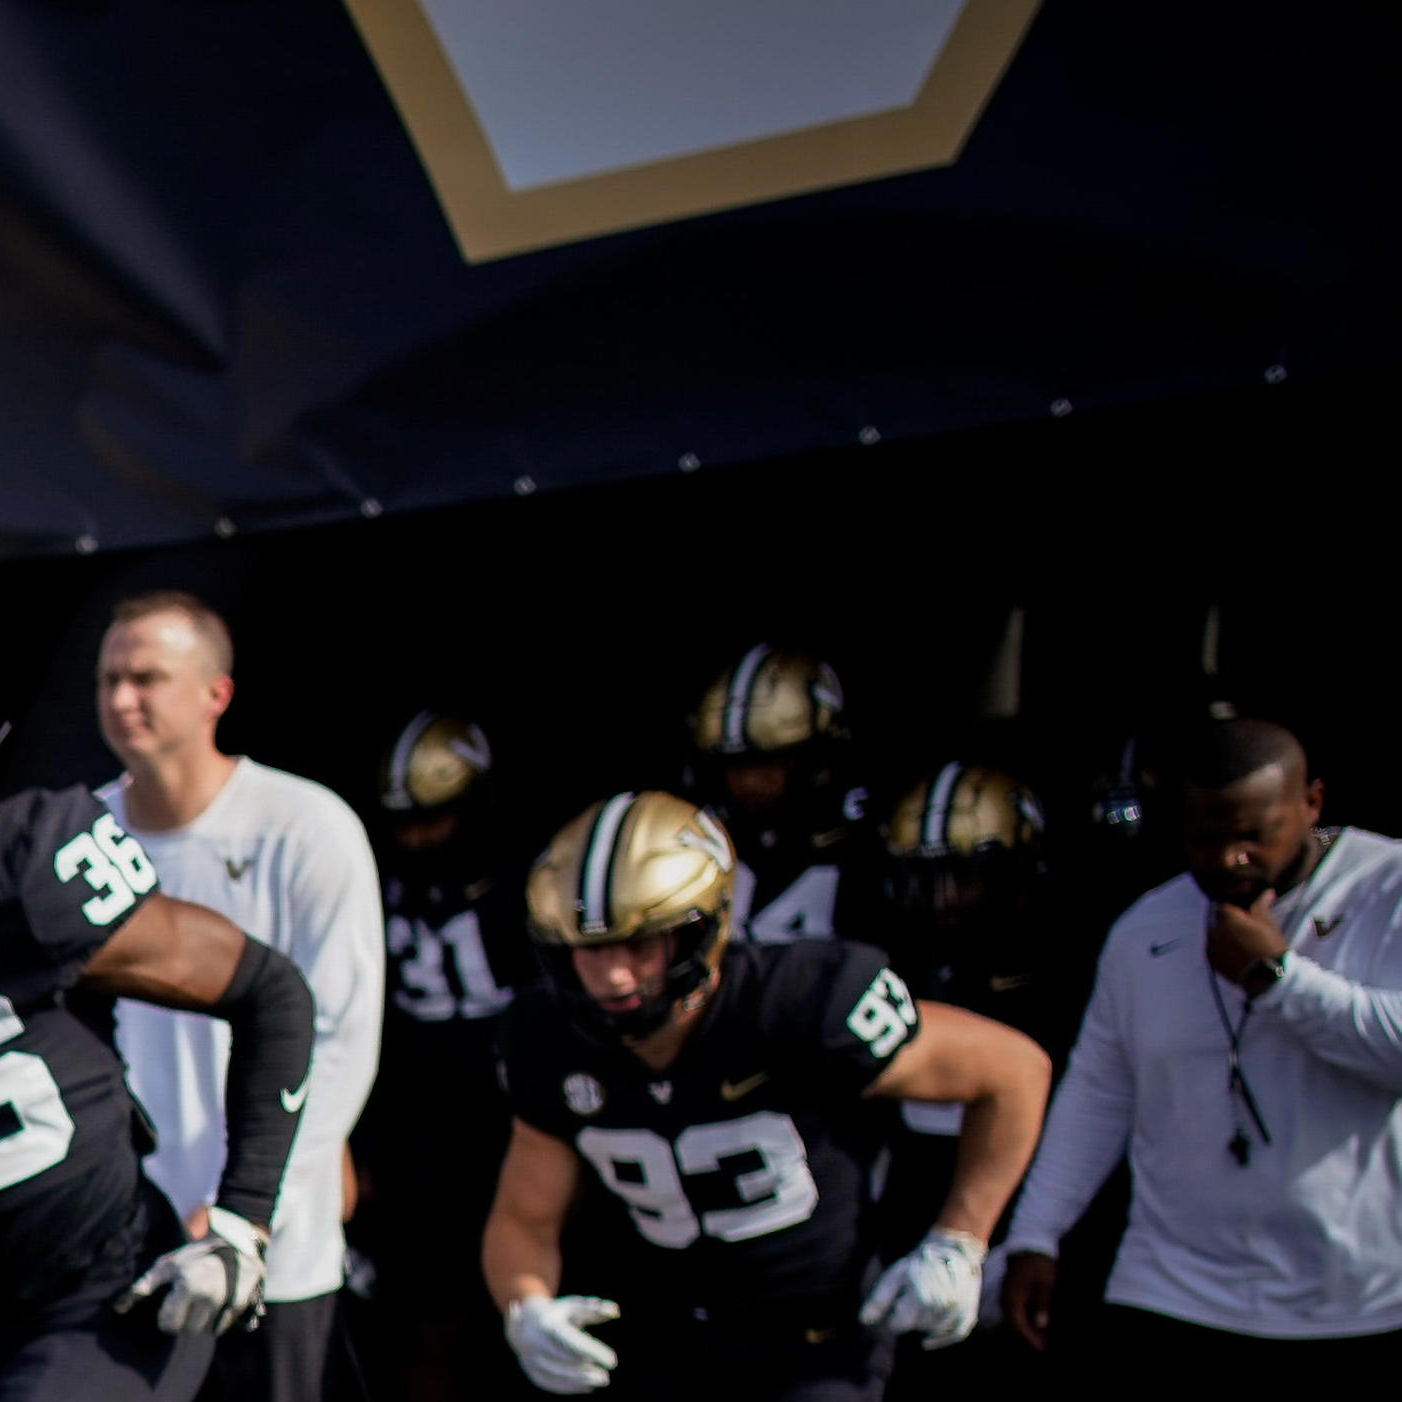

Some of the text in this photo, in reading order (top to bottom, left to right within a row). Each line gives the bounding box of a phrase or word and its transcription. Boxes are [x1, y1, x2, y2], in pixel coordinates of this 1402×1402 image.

[54, 812, 160, 927] 36
[730, 861, 840, 943] 4
[387, 908, 517, 1022] 31
[847, 966, 918, 1059] 93
[575, 1110, 819, 1250] 93
